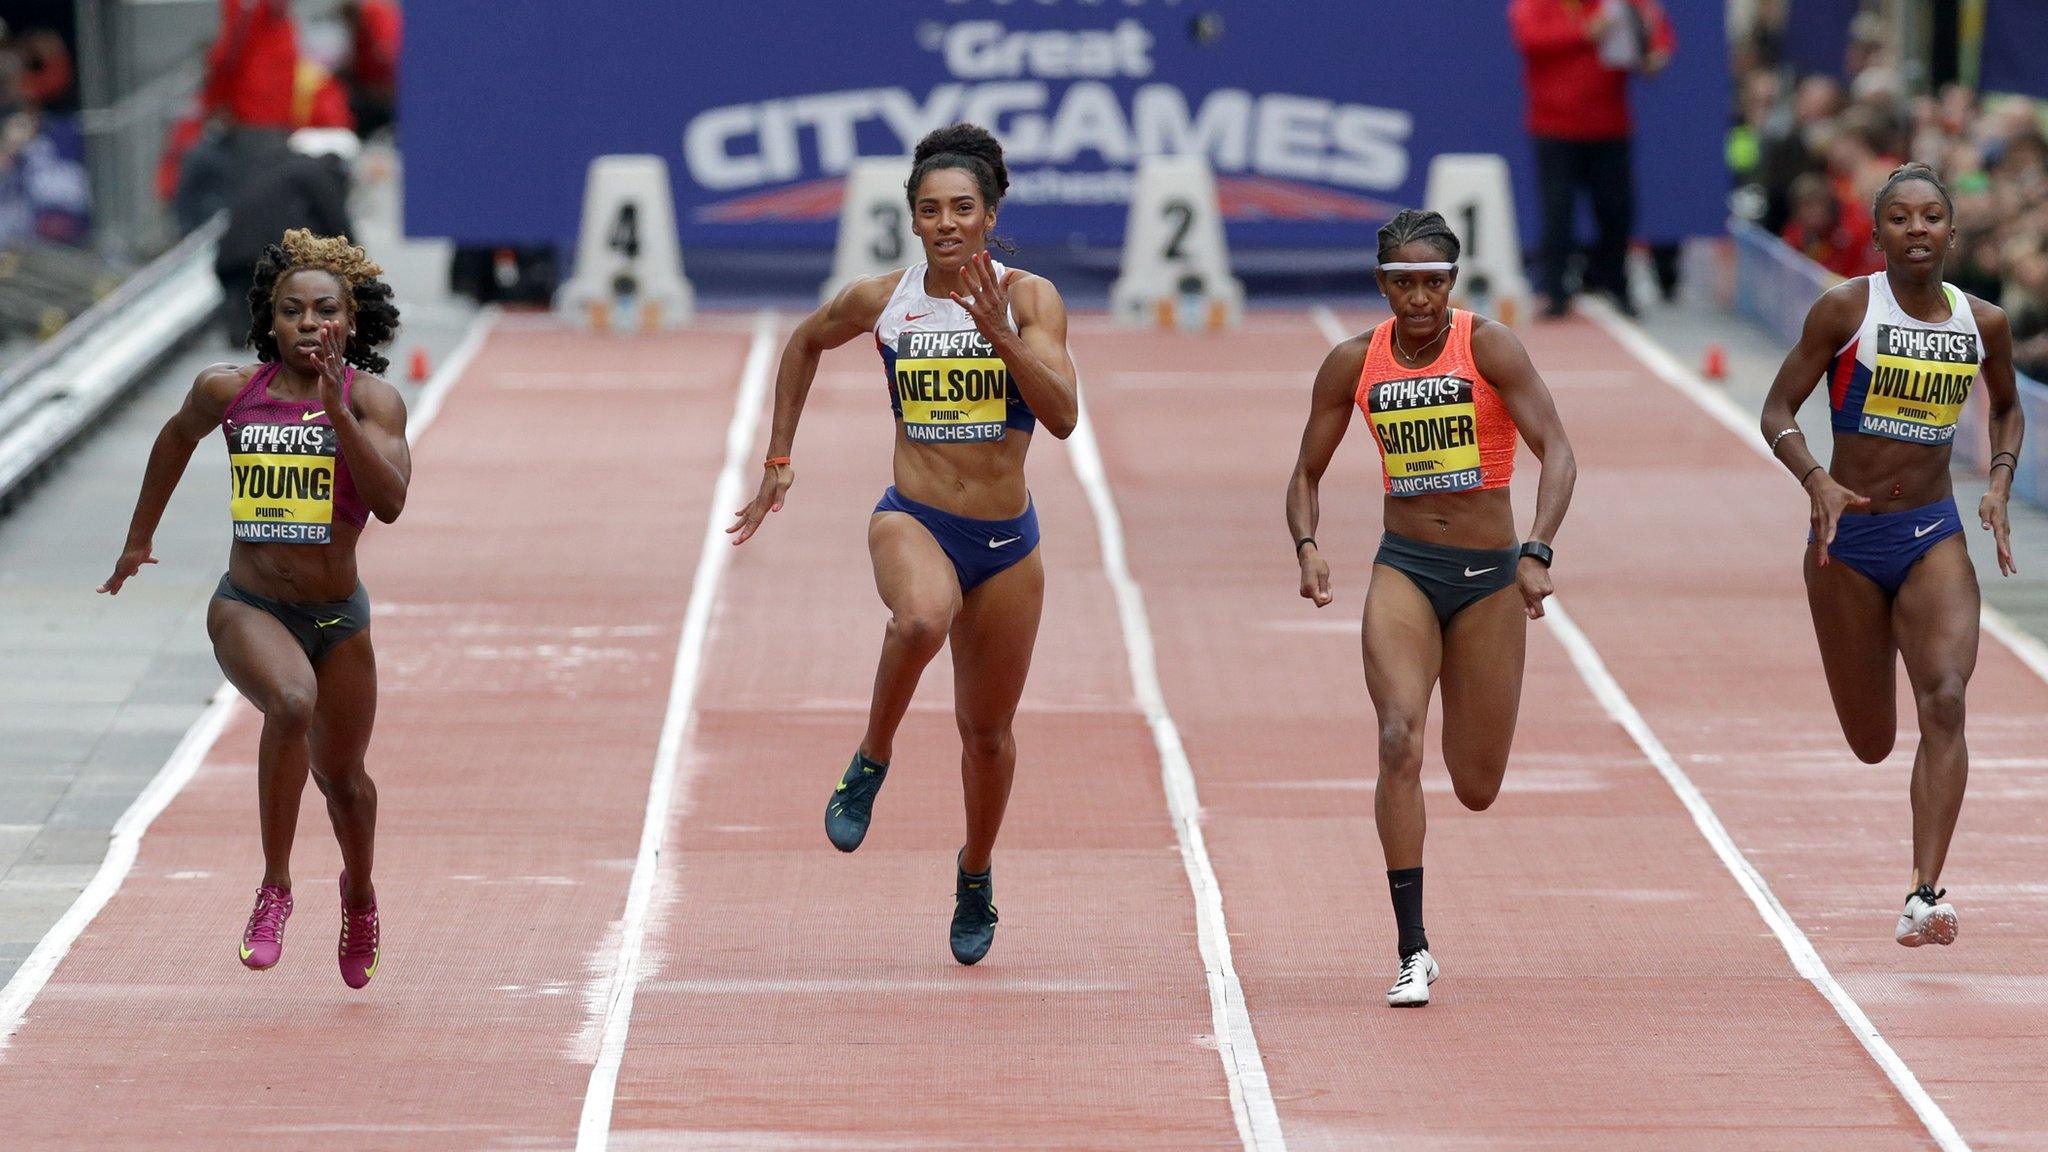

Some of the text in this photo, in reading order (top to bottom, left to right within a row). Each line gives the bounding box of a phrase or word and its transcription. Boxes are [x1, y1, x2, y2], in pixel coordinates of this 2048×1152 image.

[945, 19, 1154, 78] Great
[608, 201, 640, 258] 4
[868, 203, 905, 262] 3
[1162, 199, 1193, 259] 2
[1461, 202, 1479, 256] 1
[1889, 328, 1967, 354] ATHLETICS
[910, 349, 993, 357] WEEKLY
[1889, 346, 1967, 361] WEEKLY
[898, 369, 1004, 401] NELSON
[1380, 378, 1460, 402] ATHLETICS
[1873, 366, 1973, 405] WILLIAMS
[1380, 394, 1459, 410] WEEKLY
[1897, 407, 1928, 419] PUMA
[930, 410, 959, 420] PUMA
[240, 425, 323, 446] ATHLETICS
[907, 424, 1001, 440] MANCHESTER
[1376, 415, 1475, 455] GARDNER
[241, 444, 323, 453] WEEKLY
[1405, 460, 1434, 472] PUMA
[235, 465, 331, 500] YOUNG
[255, 507, 284, 517] PUMA
[235, 523, 326, 539] MANCHESTER
